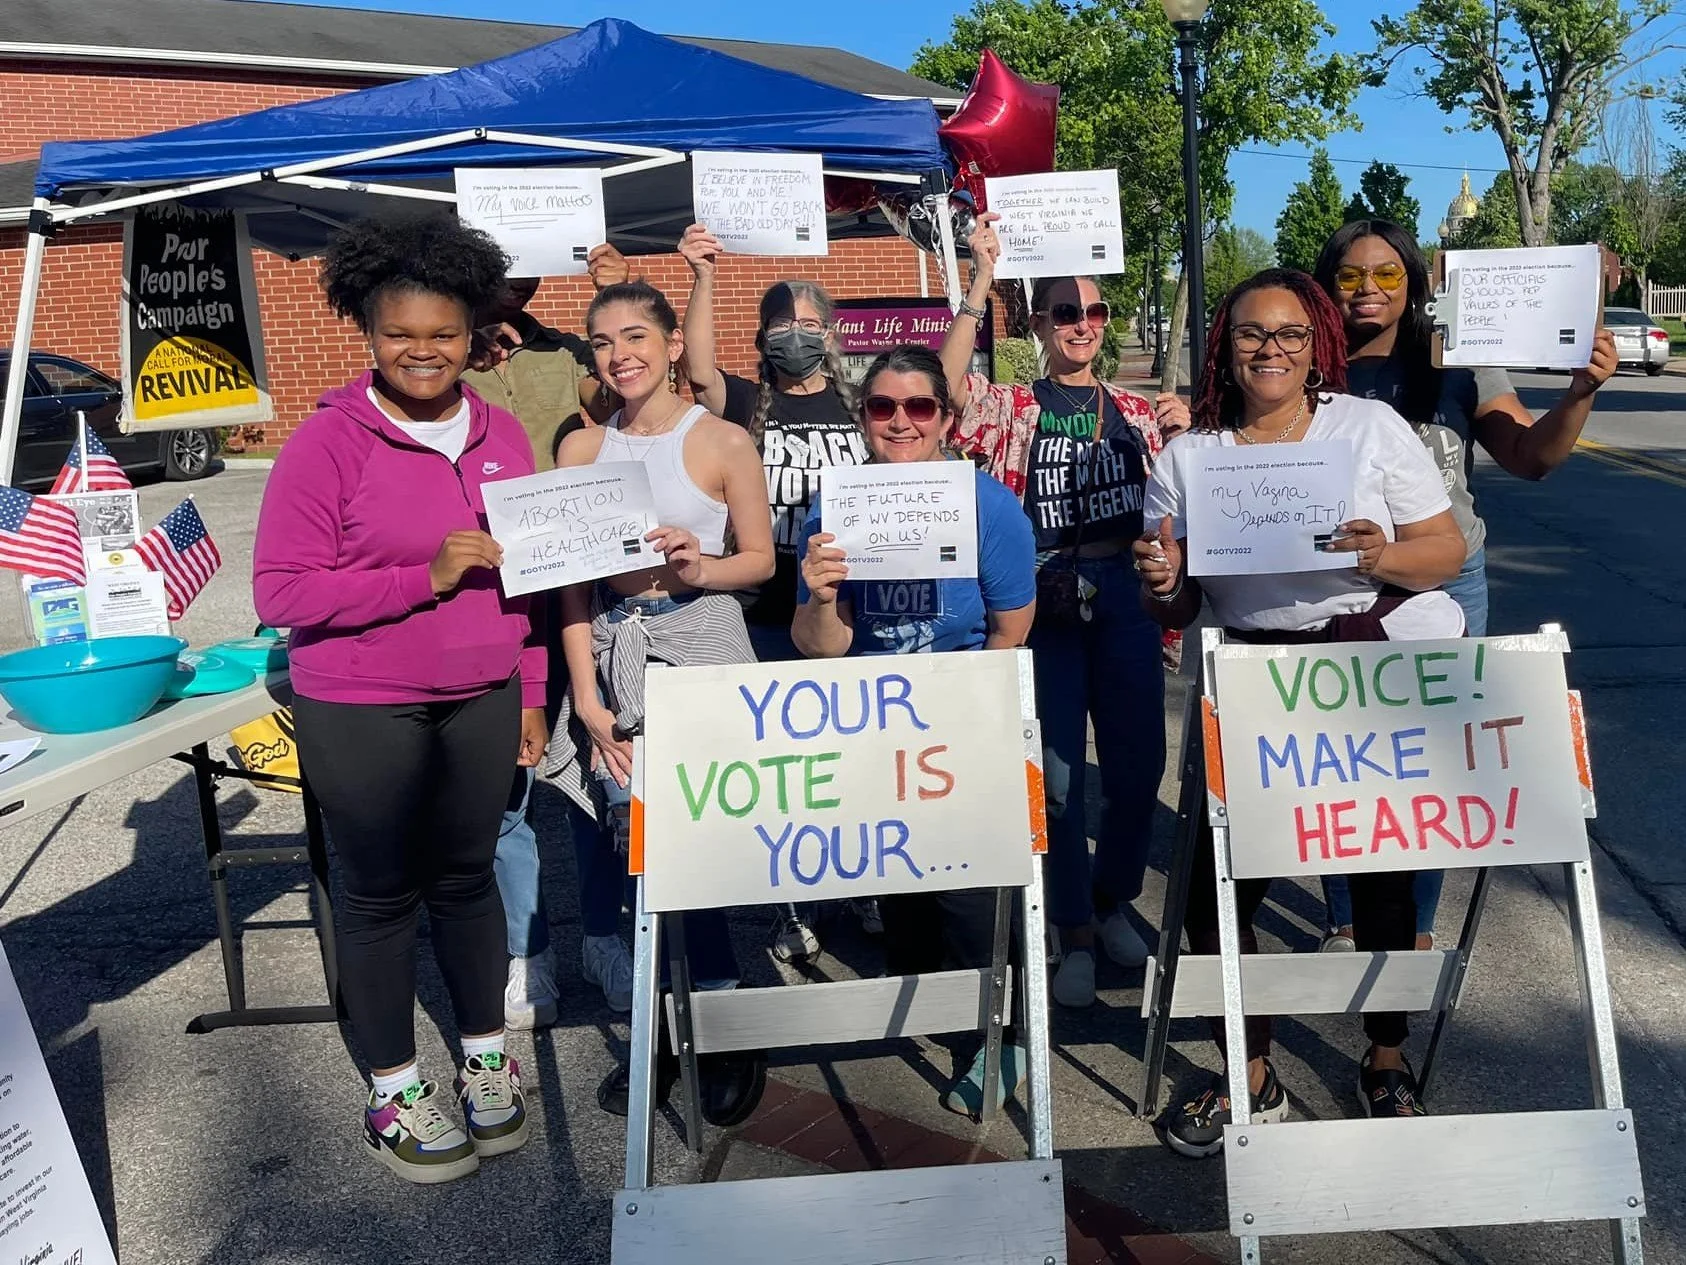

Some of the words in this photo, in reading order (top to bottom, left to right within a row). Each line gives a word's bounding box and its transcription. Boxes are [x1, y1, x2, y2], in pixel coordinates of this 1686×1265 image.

[712, 173, 746, 185] BELIEVE
[754, 176, 761, 185] IN
[765, 174, 811, 185] FREEDOM
[721, 187, 740, 198] YOU
[747, 188, 766, 198] AND
[995, 198, 1043, 207] TOGETHER
[1083, 196, 1109, 205] BUILD
[701, 201, 720, 215] WE
[729, 200, 768, 216] WON'T
[770, 201, 788, 216] GO
[792, 200, 822, 215] BACK
[1010, 211, 1034, 219] WEST
[1039, 209, 1076, 219] VIRGINIA
[716, 217, 731, 230] THE
[734, 217, 755, 231] BAD
[758, 218, 773, 229] OLD
[999, 225, 1013, 233] ARE
[1023, 224, 1038, 232] ALL
[1043, 221, 1071, 231] PROUD
[1094, 220, 1116, 229] CALL
[140, 262, 226, 300] People's
[1462, 274, 1488, 286] OUR
[1493, 272, 1546, 285] OFFICIALS
[1463, 287, 1514, 299] SHOULD
[1523, 286, 1540, 296] REP
[1463, 301, 1500, 311] VALUES
[1505, 300, 1519, 308] OF
[1524, 300, 1542, 309] THE
[137, 299, 235, 332] Campaign
[873, 316, 903, 340] Life
[910, 316, 952, 334] Minis
[848, 338, 869, 346] Pastor
[1460, 338, 1503, 346] #GOTV2022
[155, 348, 163, 359] A
[163, 344, 212, 358] NATIONAL
[147, 360, 170, 370] CALL
[172, 356, 191, 368] FOR
[193, 352, 229, 365] MORAL
[848, 357, 866, 366] LIFE
[141, 364, 249, 402] REVIVAL
[1038, 437, 1072, 463] THE
[1216, 465, 1235, 473] voting
[515, 491, 535, 500] voting
[570, 480, 594, 489] election
[1035, 466, 1071, 496] THE
[828, 496, 856, 509] THE
[868, 491, 944, 506] FUTURE
[1251, 477, 1309, 505] Vagina
[519, 488, 624, 531] ABORTION
[843, 514, 860, 527] OF
[870, 513, 889, 525] WV
[894, 509, 960, 524] DEPENDS
[1037, 499, 1075, 529] THE
[569, 516, 590, 533] IS
[869, 532, 889, 545] ON
[899, 526, 929, 542] US!
[1206, 547, 1251, 555] #GOTV2022
[520, 561, 566, 576] #GOTV2022
[878, 584, 931, 612] VOTE
[1267, 643, 1485, 712] VOICE!
[738, 674, 931, 741] YOUR
[1257, 727, 1430, 788] MAKE
[1464, 716, 1525, 771] IT
[676, 751, 842, 821] VOTE
[895, 745, 955, 801] IS
[1294, 787, 1520, 862] HEARD!
[754, 819, 969, 887] YOUR...
[3, 1088, 12, 1097] on
[13, 1122, 20, 1132] to
[1, 1140, 33, 1166] affordable
[7, 1193, 15, 1203] to
[15, 1178, 35, 1197] invest
[35, 1172, 42, 1183] in
[42, 1165, 53, 1177] our
[6, 1198, 22, 1217] West
[23, 1183, 47, 1206] Virginia
